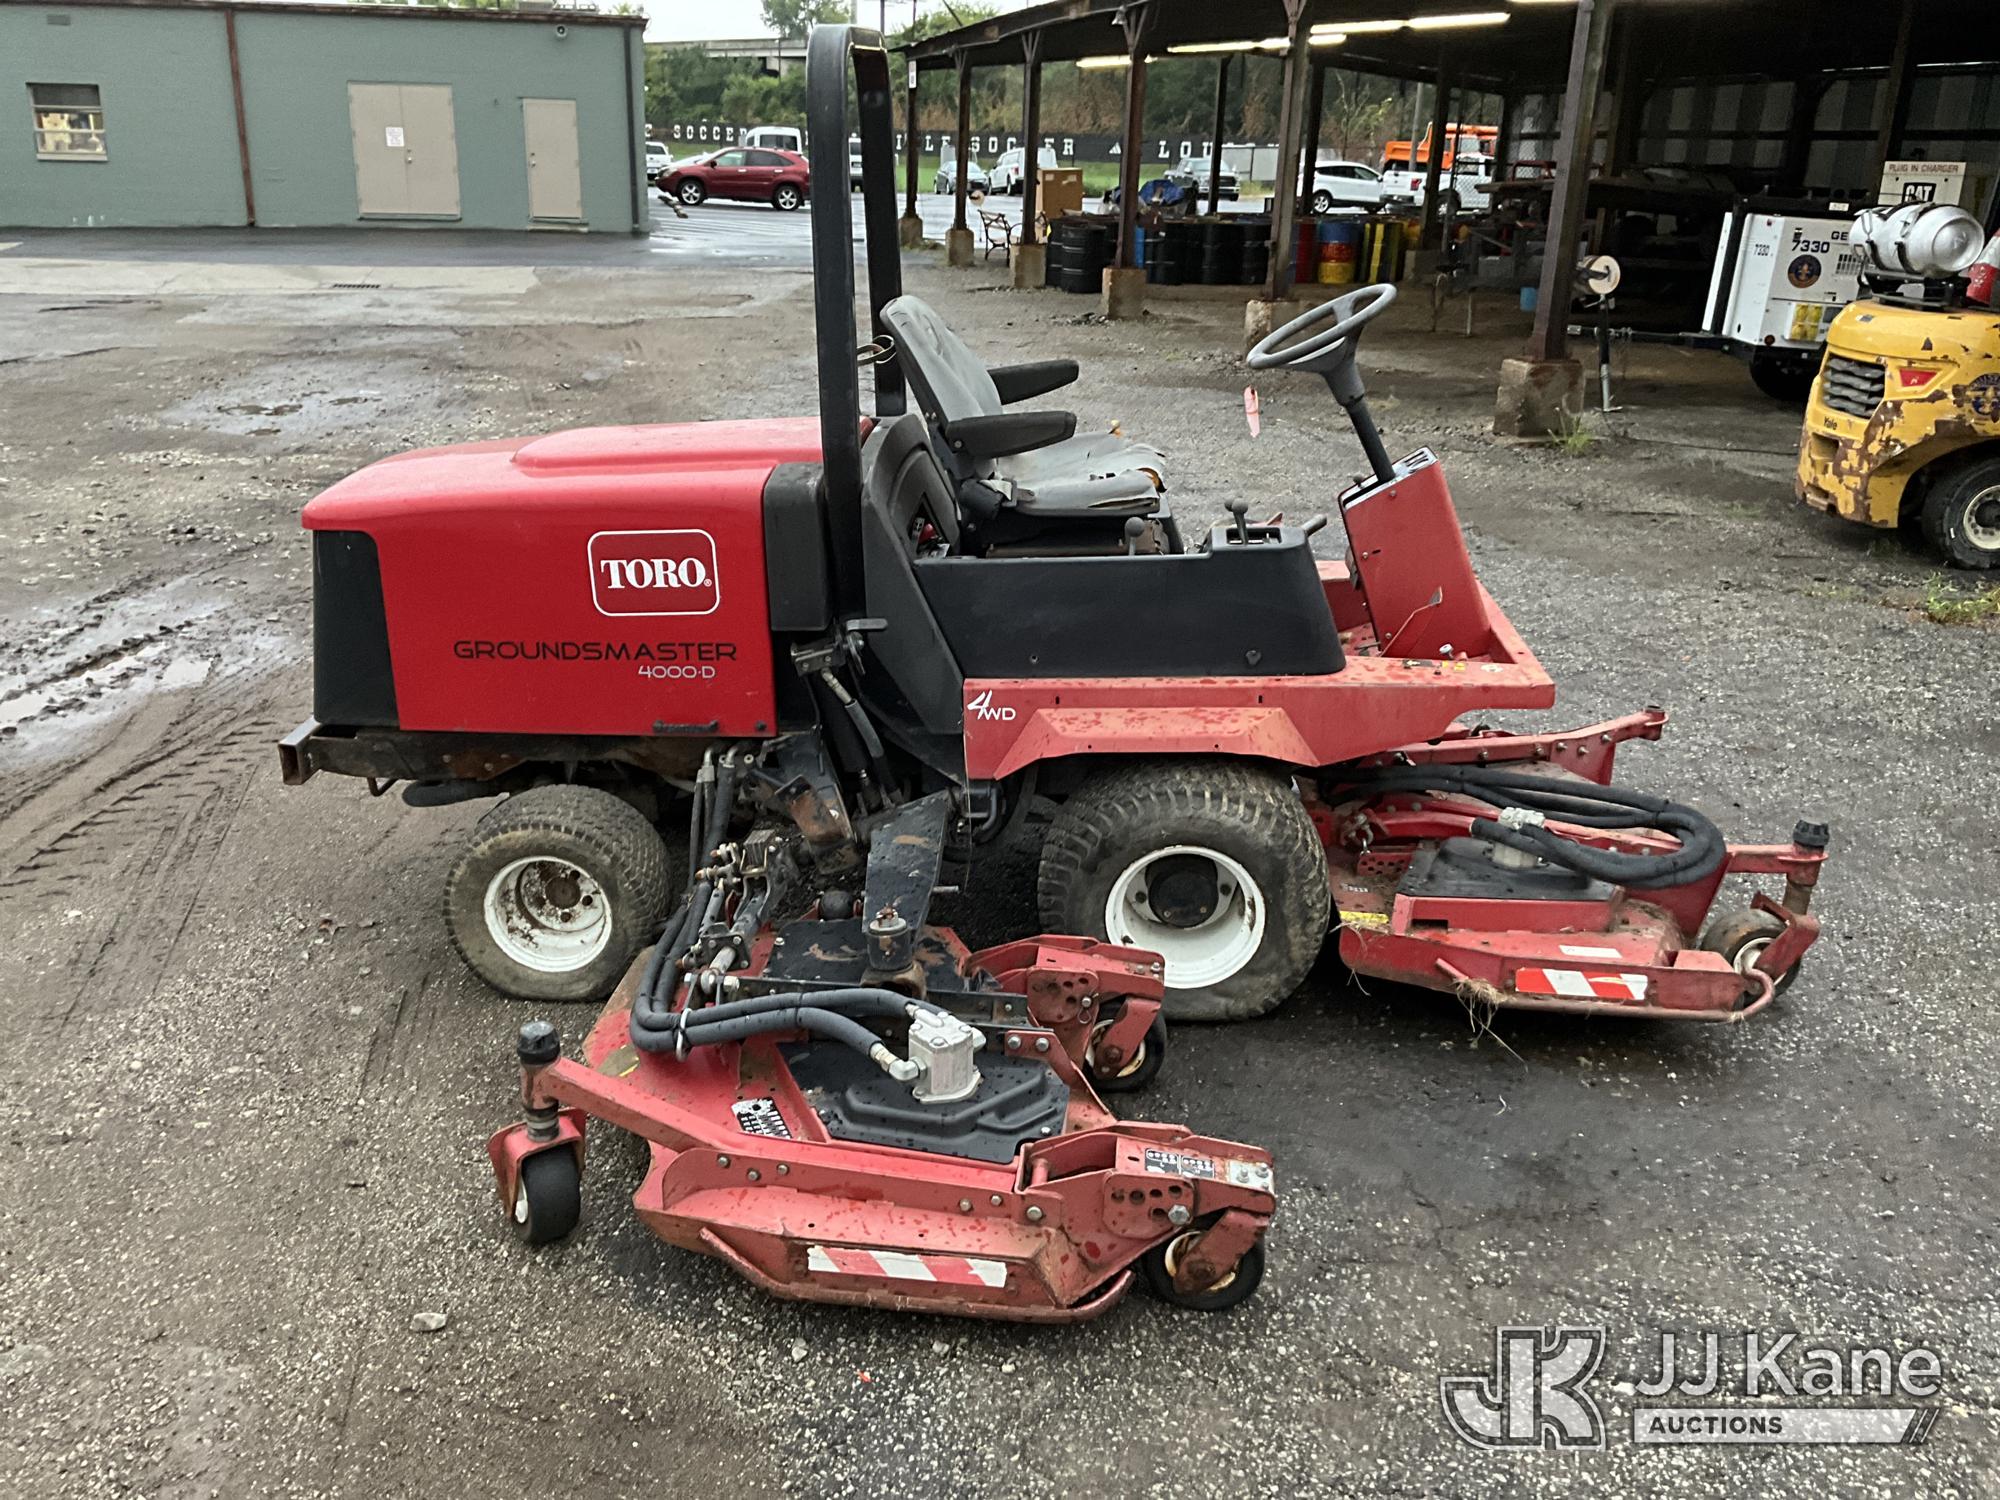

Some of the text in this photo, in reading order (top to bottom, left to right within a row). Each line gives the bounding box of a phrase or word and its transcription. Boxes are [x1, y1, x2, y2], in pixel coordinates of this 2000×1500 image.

[969, 135, 1074, 155] SOCER
[1911, 164, 1918, 172] IN
[1921, 164, 1959, 173] CHARGER
[1791, 239, 1831, 254] 7330
[453, 640, 737, 661] GROUNDSMASTER
[967, 690, 1016, 720] 4WD
